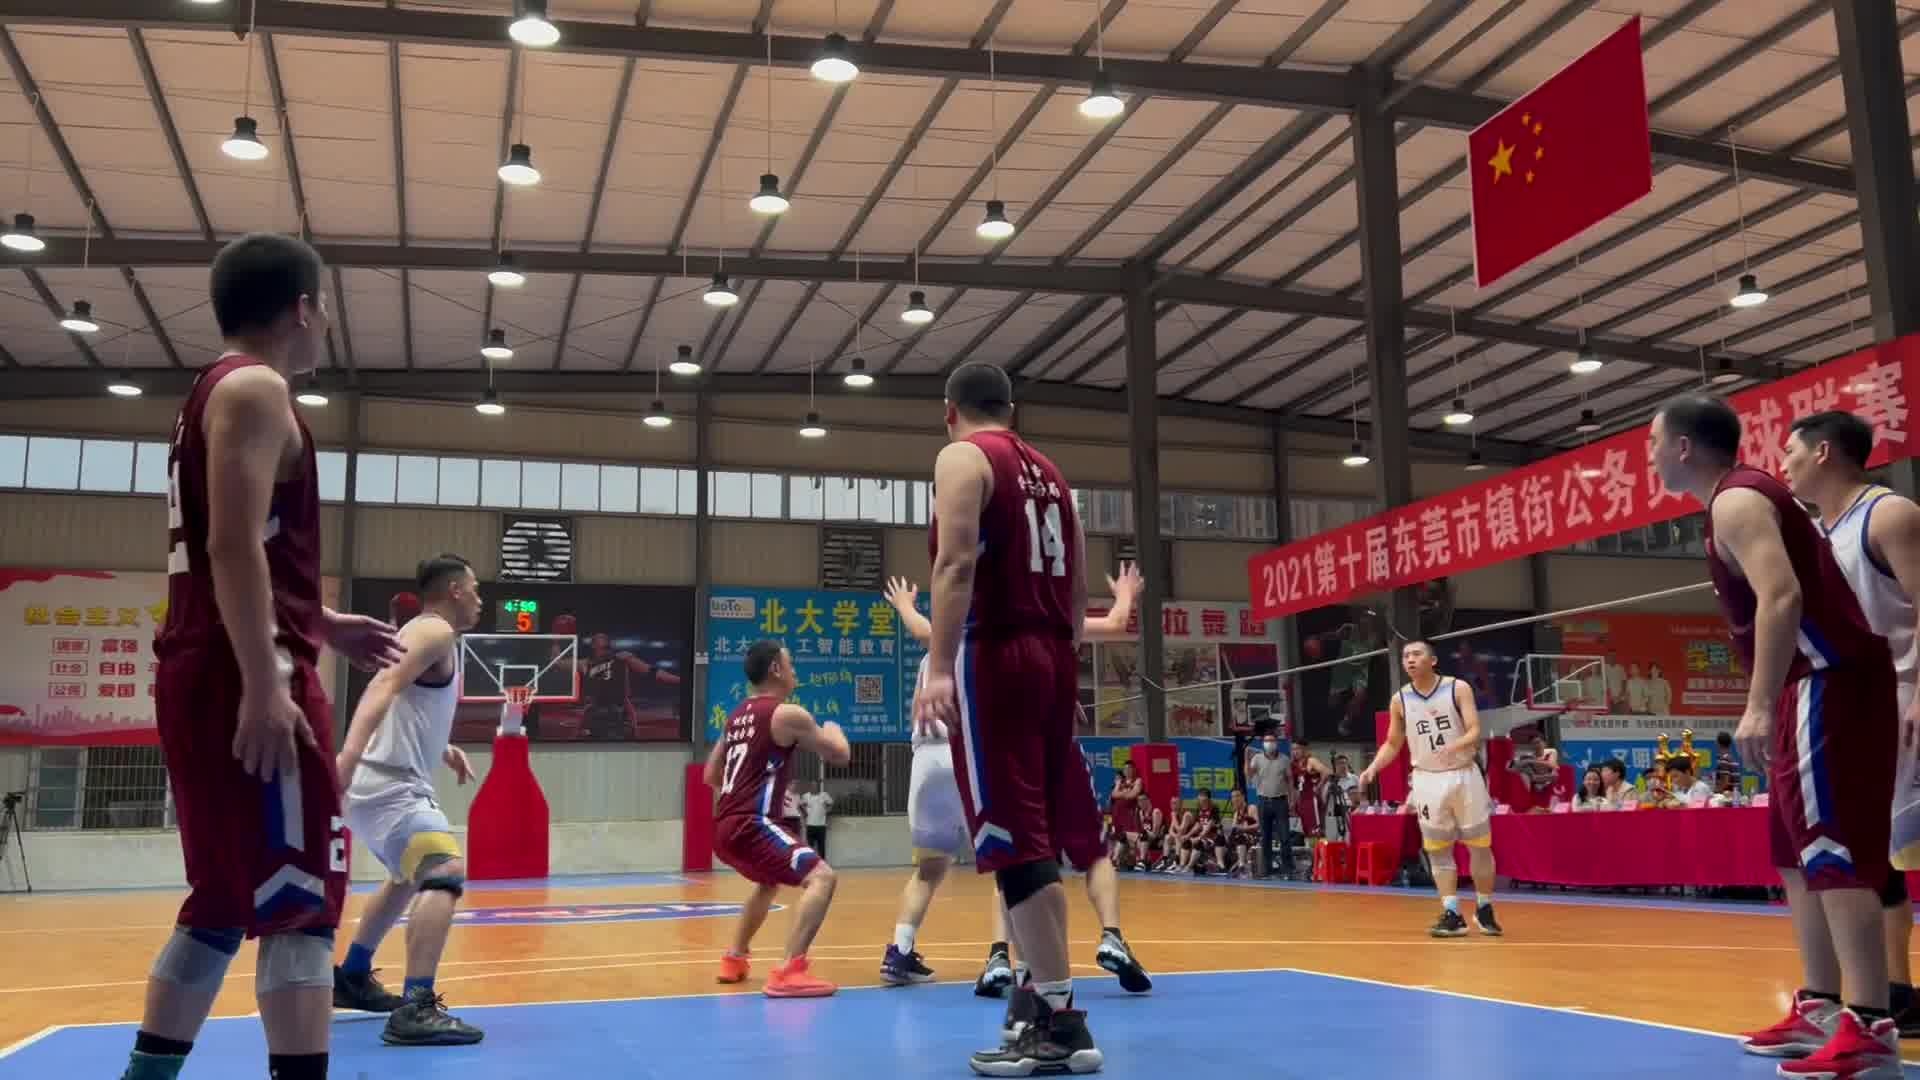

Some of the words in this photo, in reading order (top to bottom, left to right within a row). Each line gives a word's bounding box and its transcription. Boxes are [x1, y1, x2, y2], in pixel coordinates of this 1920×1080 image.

[1025, 499, 1066, 577] 14
[517, 613, 532, 632] 5
[760, 598, 897, 636] 北大学堂
[99, 662, 136, 676] 自由
[1416, 714, 1451, 736] 企石
[1428, 733, 1447, 751] 14
